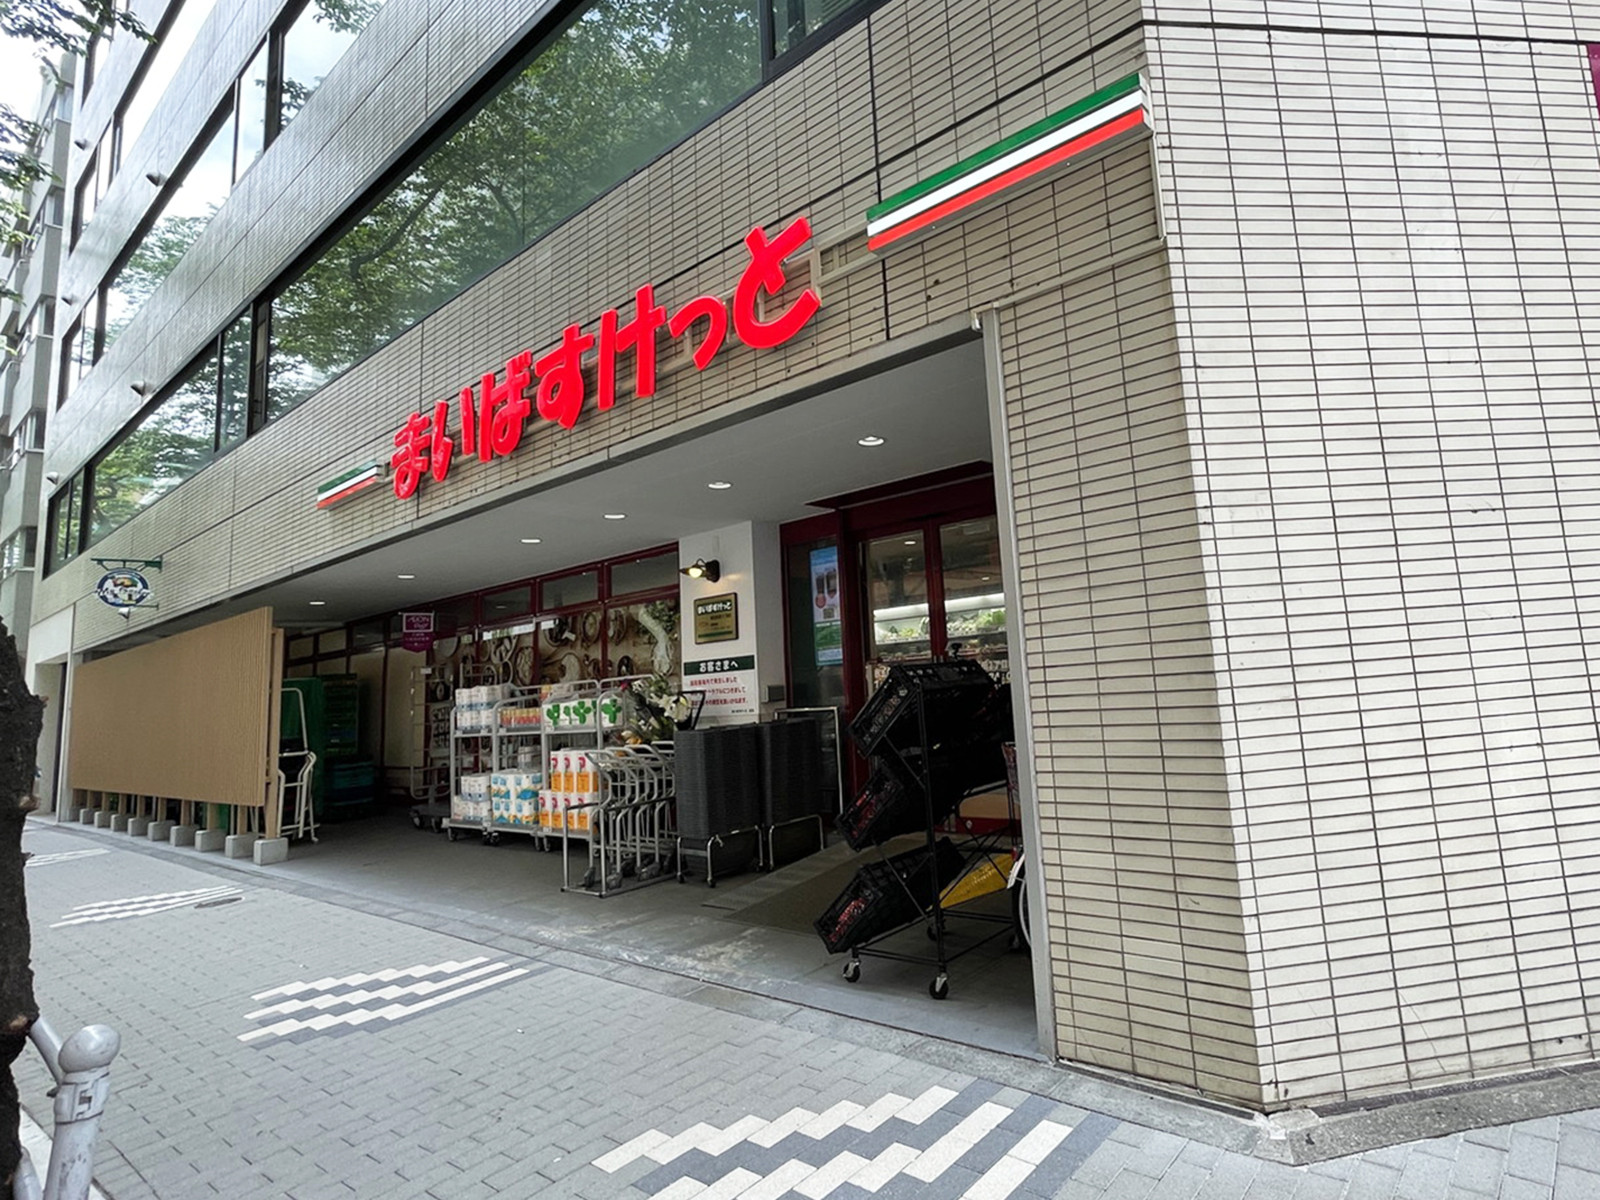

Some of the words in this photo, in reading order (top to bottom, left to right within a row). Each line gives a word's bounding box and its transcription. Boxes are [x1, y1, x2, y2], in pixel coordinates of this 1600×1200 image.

[391, 216, 821, 500] まいばすけっと
[699, 660, 738, 673] お客さまへ
